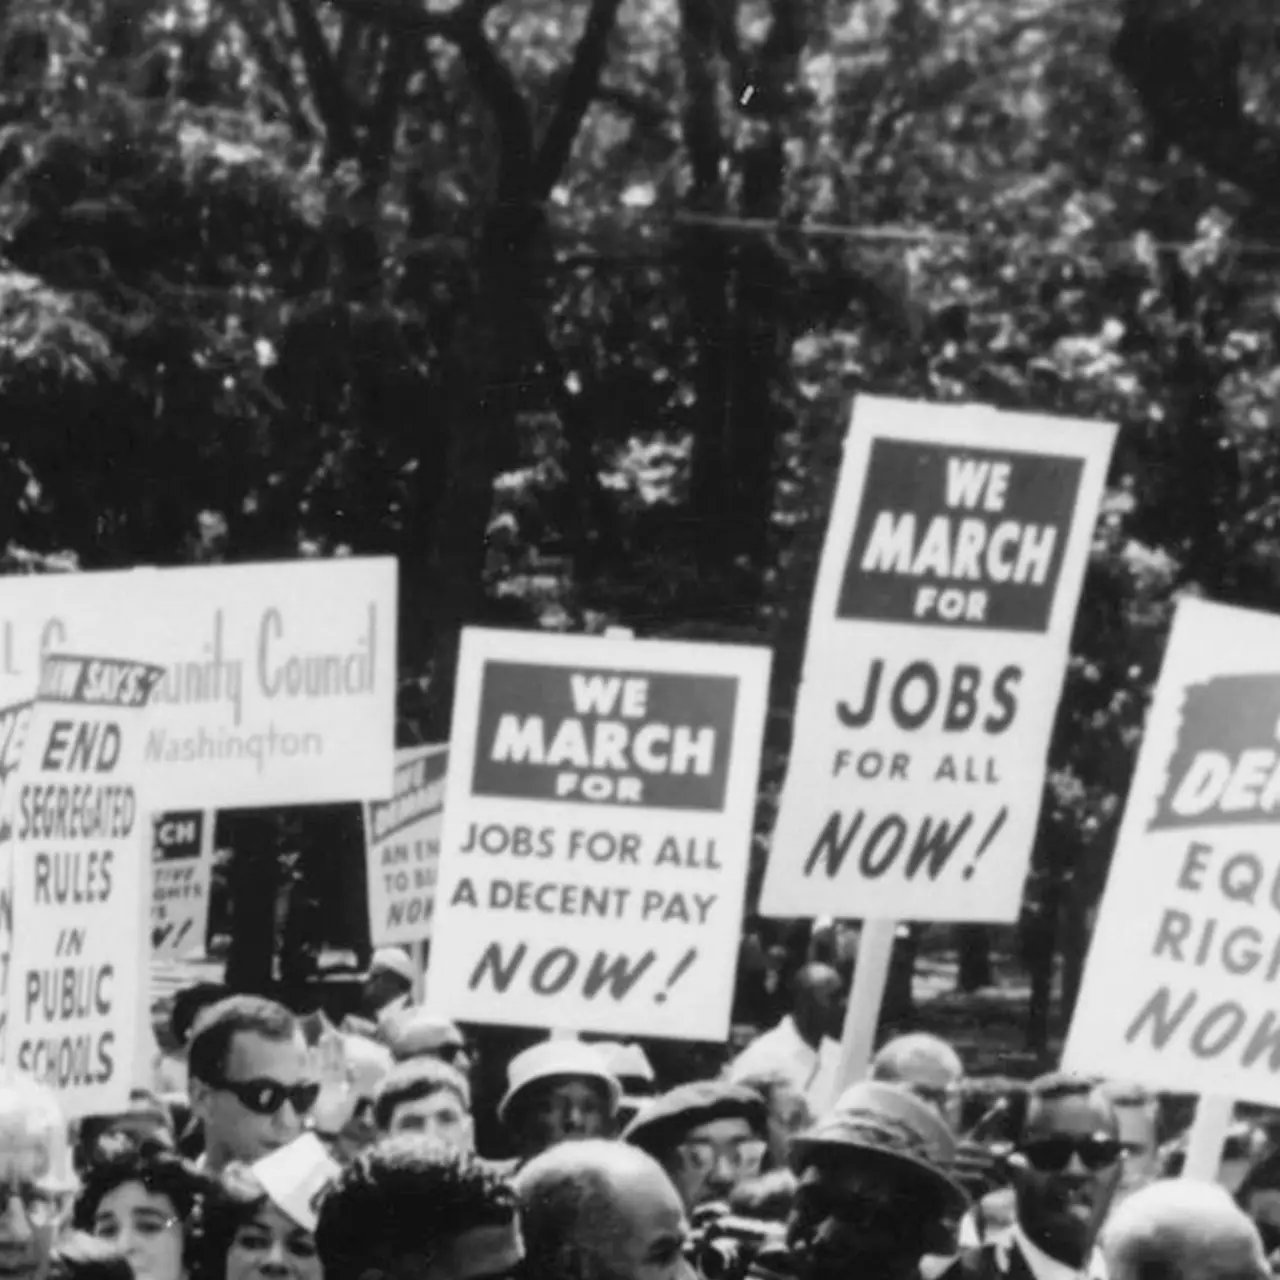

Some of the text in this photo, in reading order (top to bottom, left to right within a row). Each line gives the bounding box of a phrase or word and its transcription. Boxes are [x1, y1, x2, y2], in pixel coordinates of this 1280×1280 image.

[943, 456, 1011, 513] WE
[861, 511, 1056, 586] MARCH
[915, 589, 988, 622] FOR
[257, 603, 377, 698] Council
[570, 673, 648, 719] WE
[836, 658, 1023, 733] JOBS
[41, 720, 122, 772] END
[490, 713, 716, 776] MARCH
[833, 749, 1001, 783] FOR ALL
[20, 785, 136, 840] SEGREGATED
[556, 773, 643, 803] FOR
[460, 823, 722, 869] JOBS FOR ALL
[803, 805, 1008, 881] NOW!
[34, 851, 113, 905] RULES
[450, 879, 718, 925] A DECENT PAY
[55, 929, 86, 957] IN
[25, 965, 114, 1024] PUBLIC
[467, 941, 696, 1005] NOW!
[18, 1032, 115, 1089] SCHOOLS
